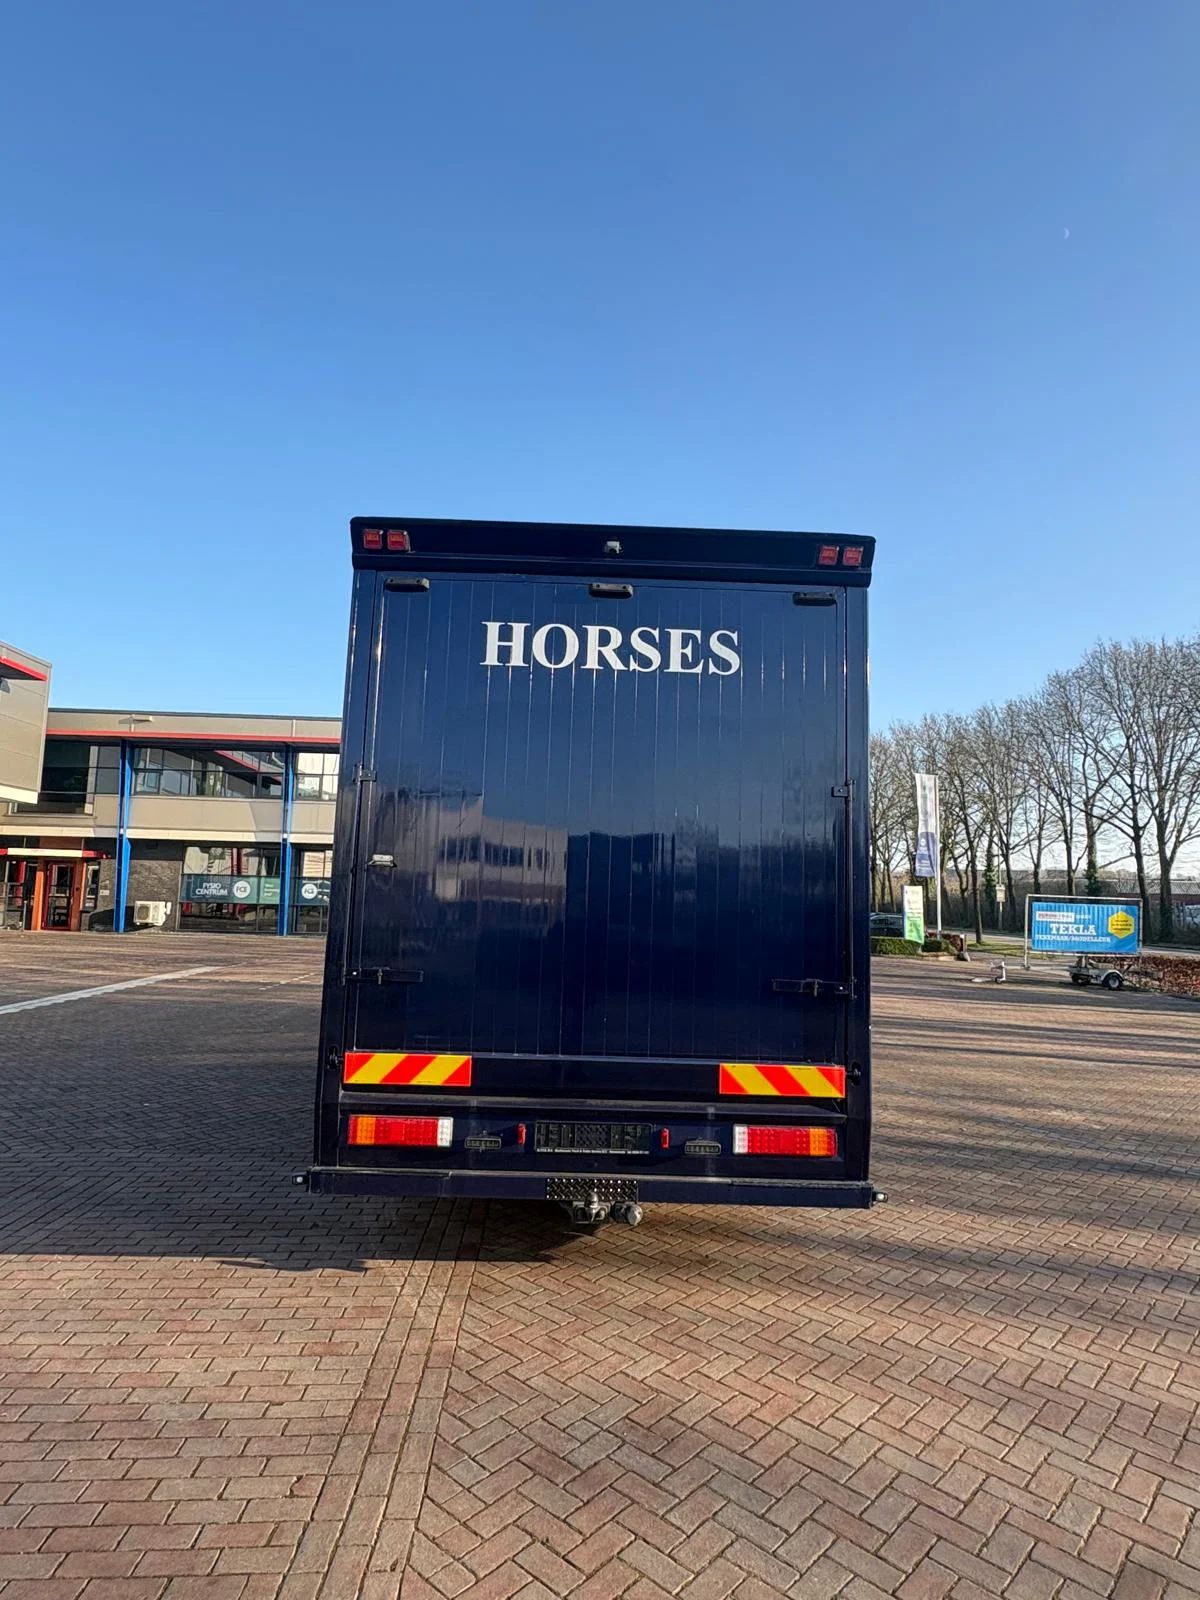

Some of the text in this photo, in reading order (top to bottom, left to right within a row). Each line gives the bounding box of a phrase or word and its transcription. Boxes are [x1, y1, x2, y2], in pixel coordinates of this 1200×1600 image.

[479, 621, 741, 676] HORSES
[203, 882, 221, 890] FYSIO
[195, 888, 228, 896] CENTRUM
[1050, 923, 1097, 936] TEKLA
